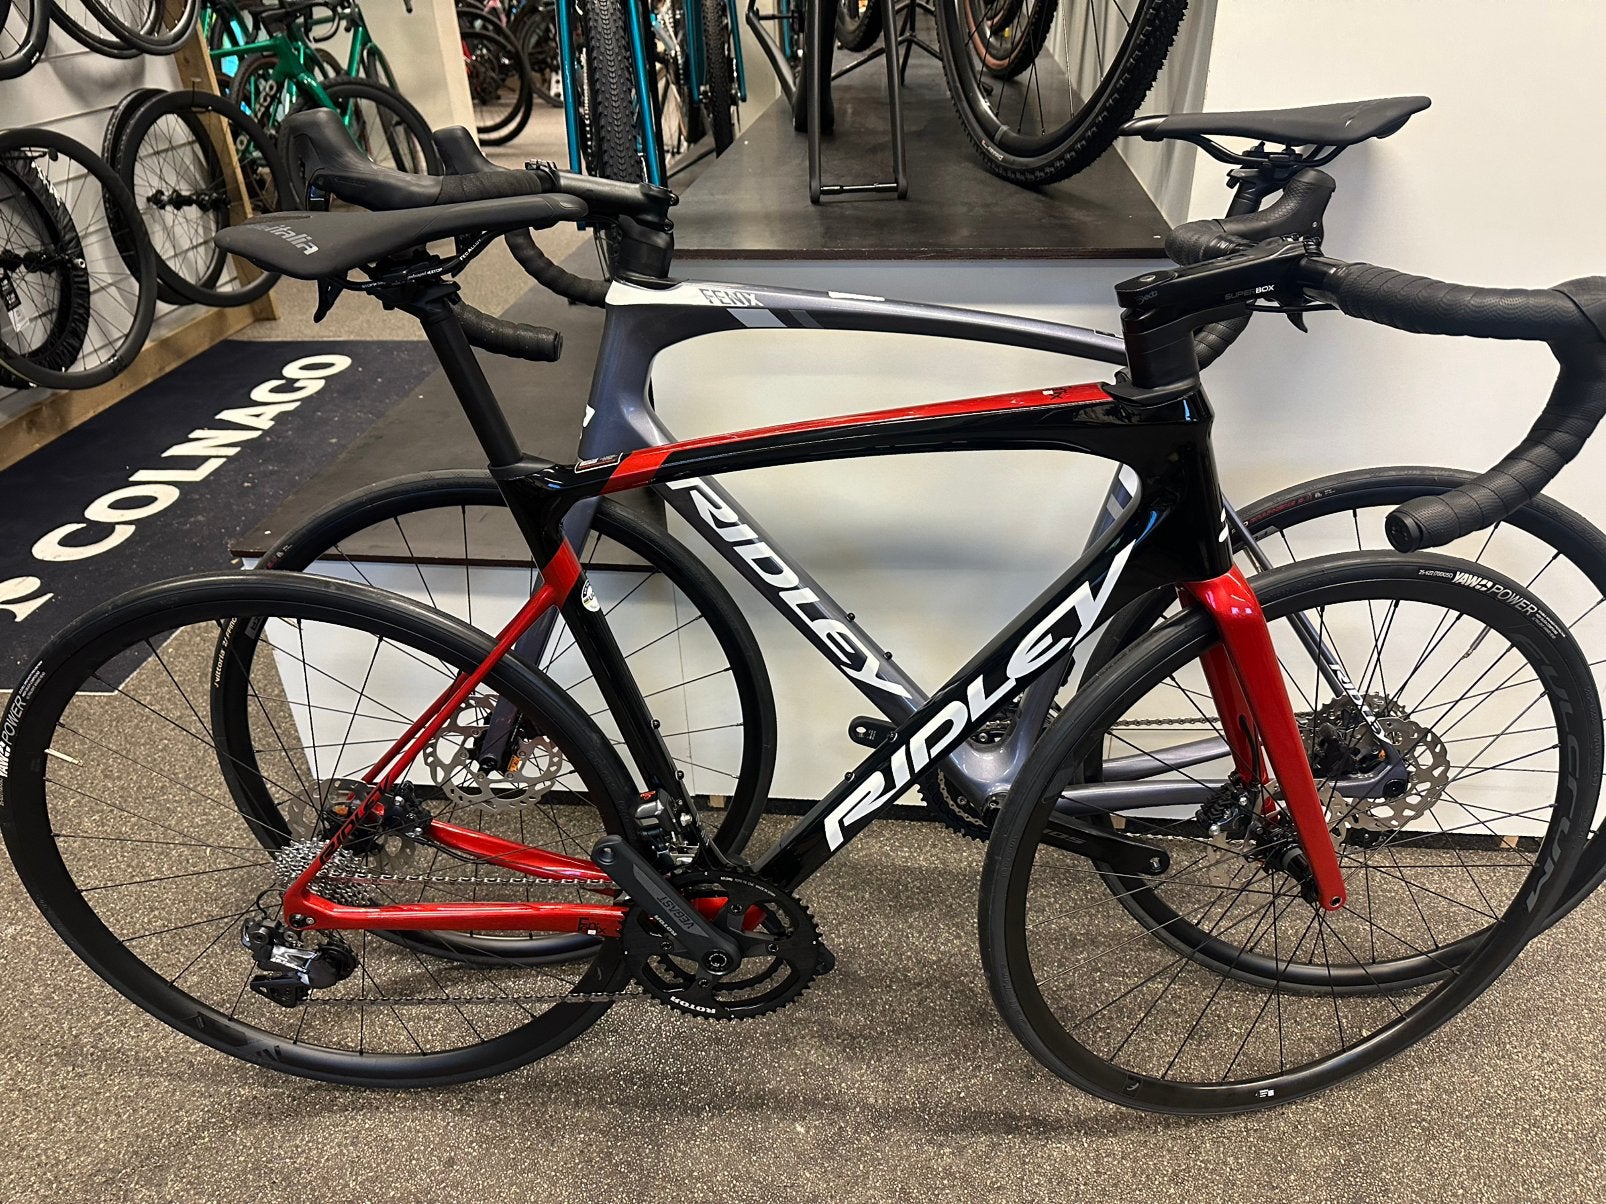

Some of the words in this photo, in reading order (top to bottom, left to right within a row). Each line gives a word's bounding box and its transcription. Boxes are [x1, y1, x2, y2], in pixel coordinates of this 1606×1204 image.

[31, 354, 352, 562] COLNAGO
[666, 477, 913, 699] RIDLEY
[1451, 571, 1481, 589] YAW
[1487, 585, 1538, 616] POWER
[824, 539, 1136, 852] RIDLEY
[1, 695, 27, 746] POWER
[654, 914, 678, 937] ROTOR
[657, 896, 695, 930] VEGAST
[670, 995, 716, 1014] ROTOR
